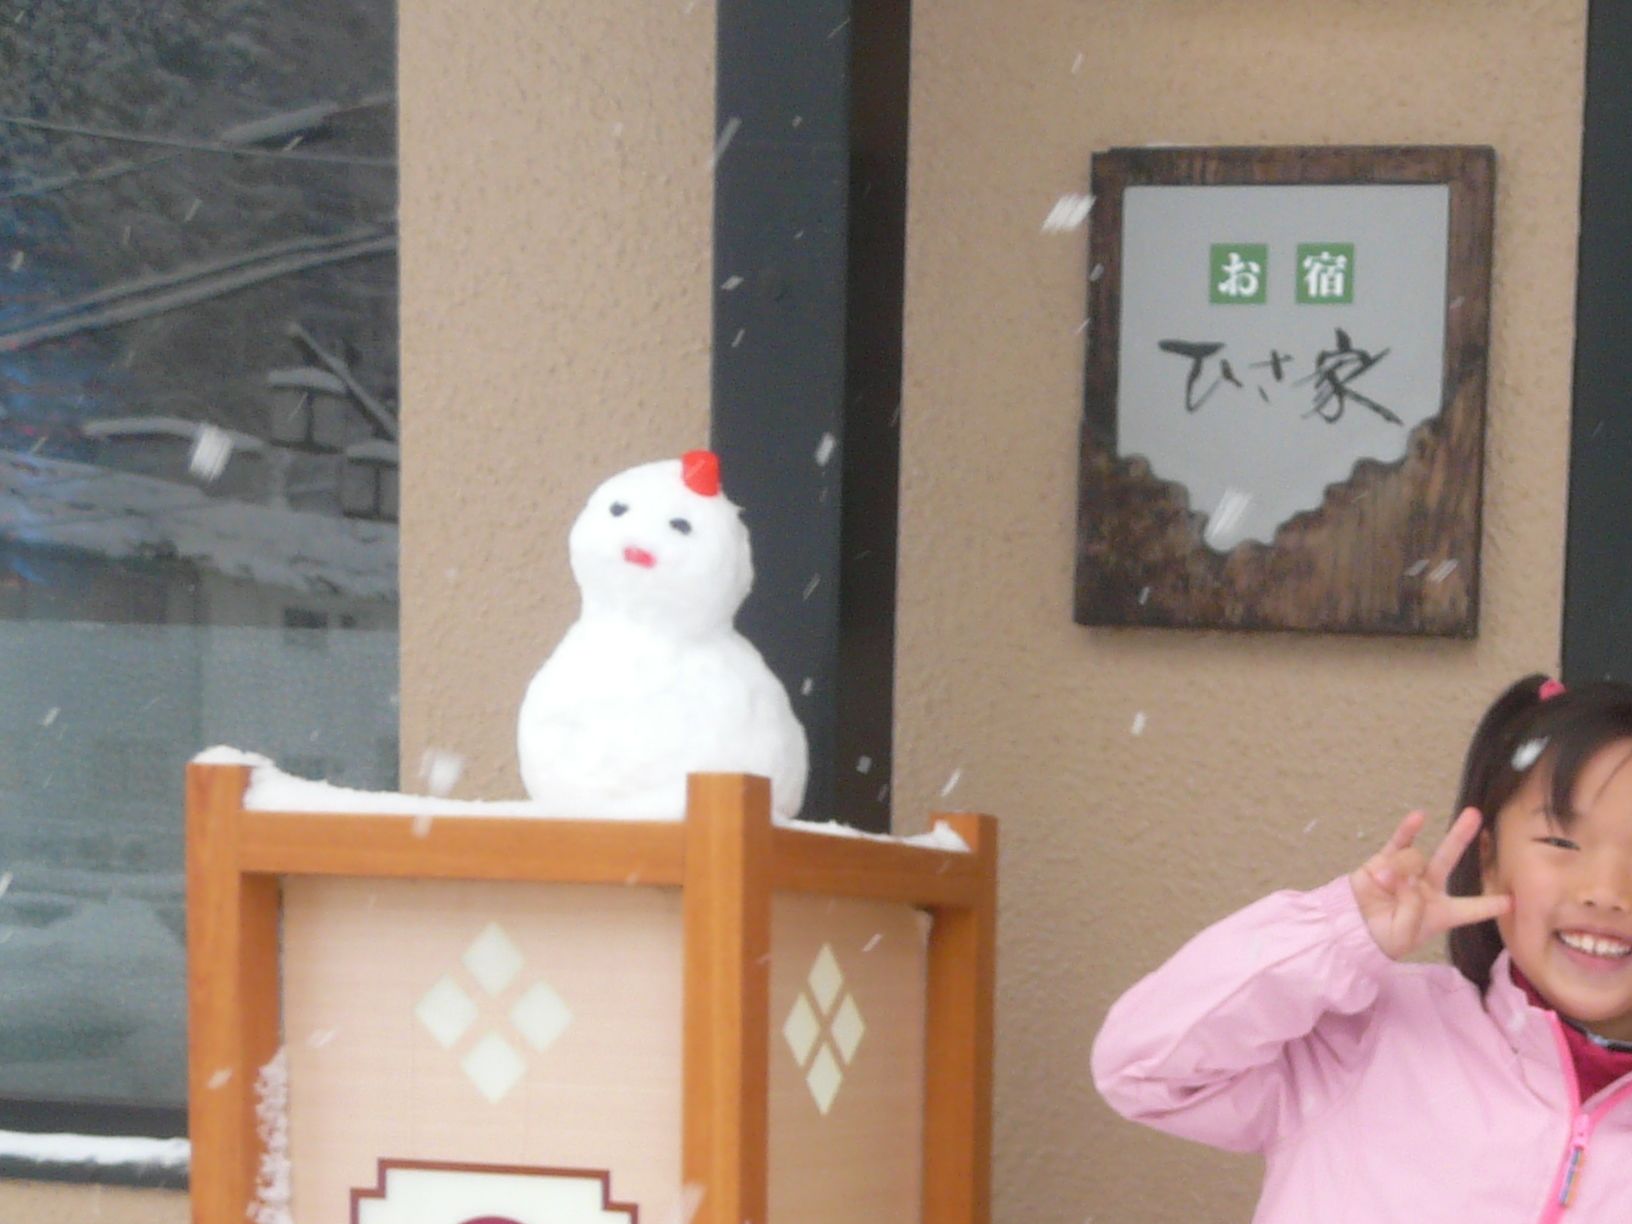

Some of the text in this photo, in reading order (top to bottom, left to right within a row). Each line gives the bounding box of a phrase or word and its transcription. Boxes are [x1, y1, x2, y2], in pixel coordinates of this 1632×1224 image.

[1218, 252, 1349, 298] お宿
[1158, 327, 1404, 424] ひさ家
